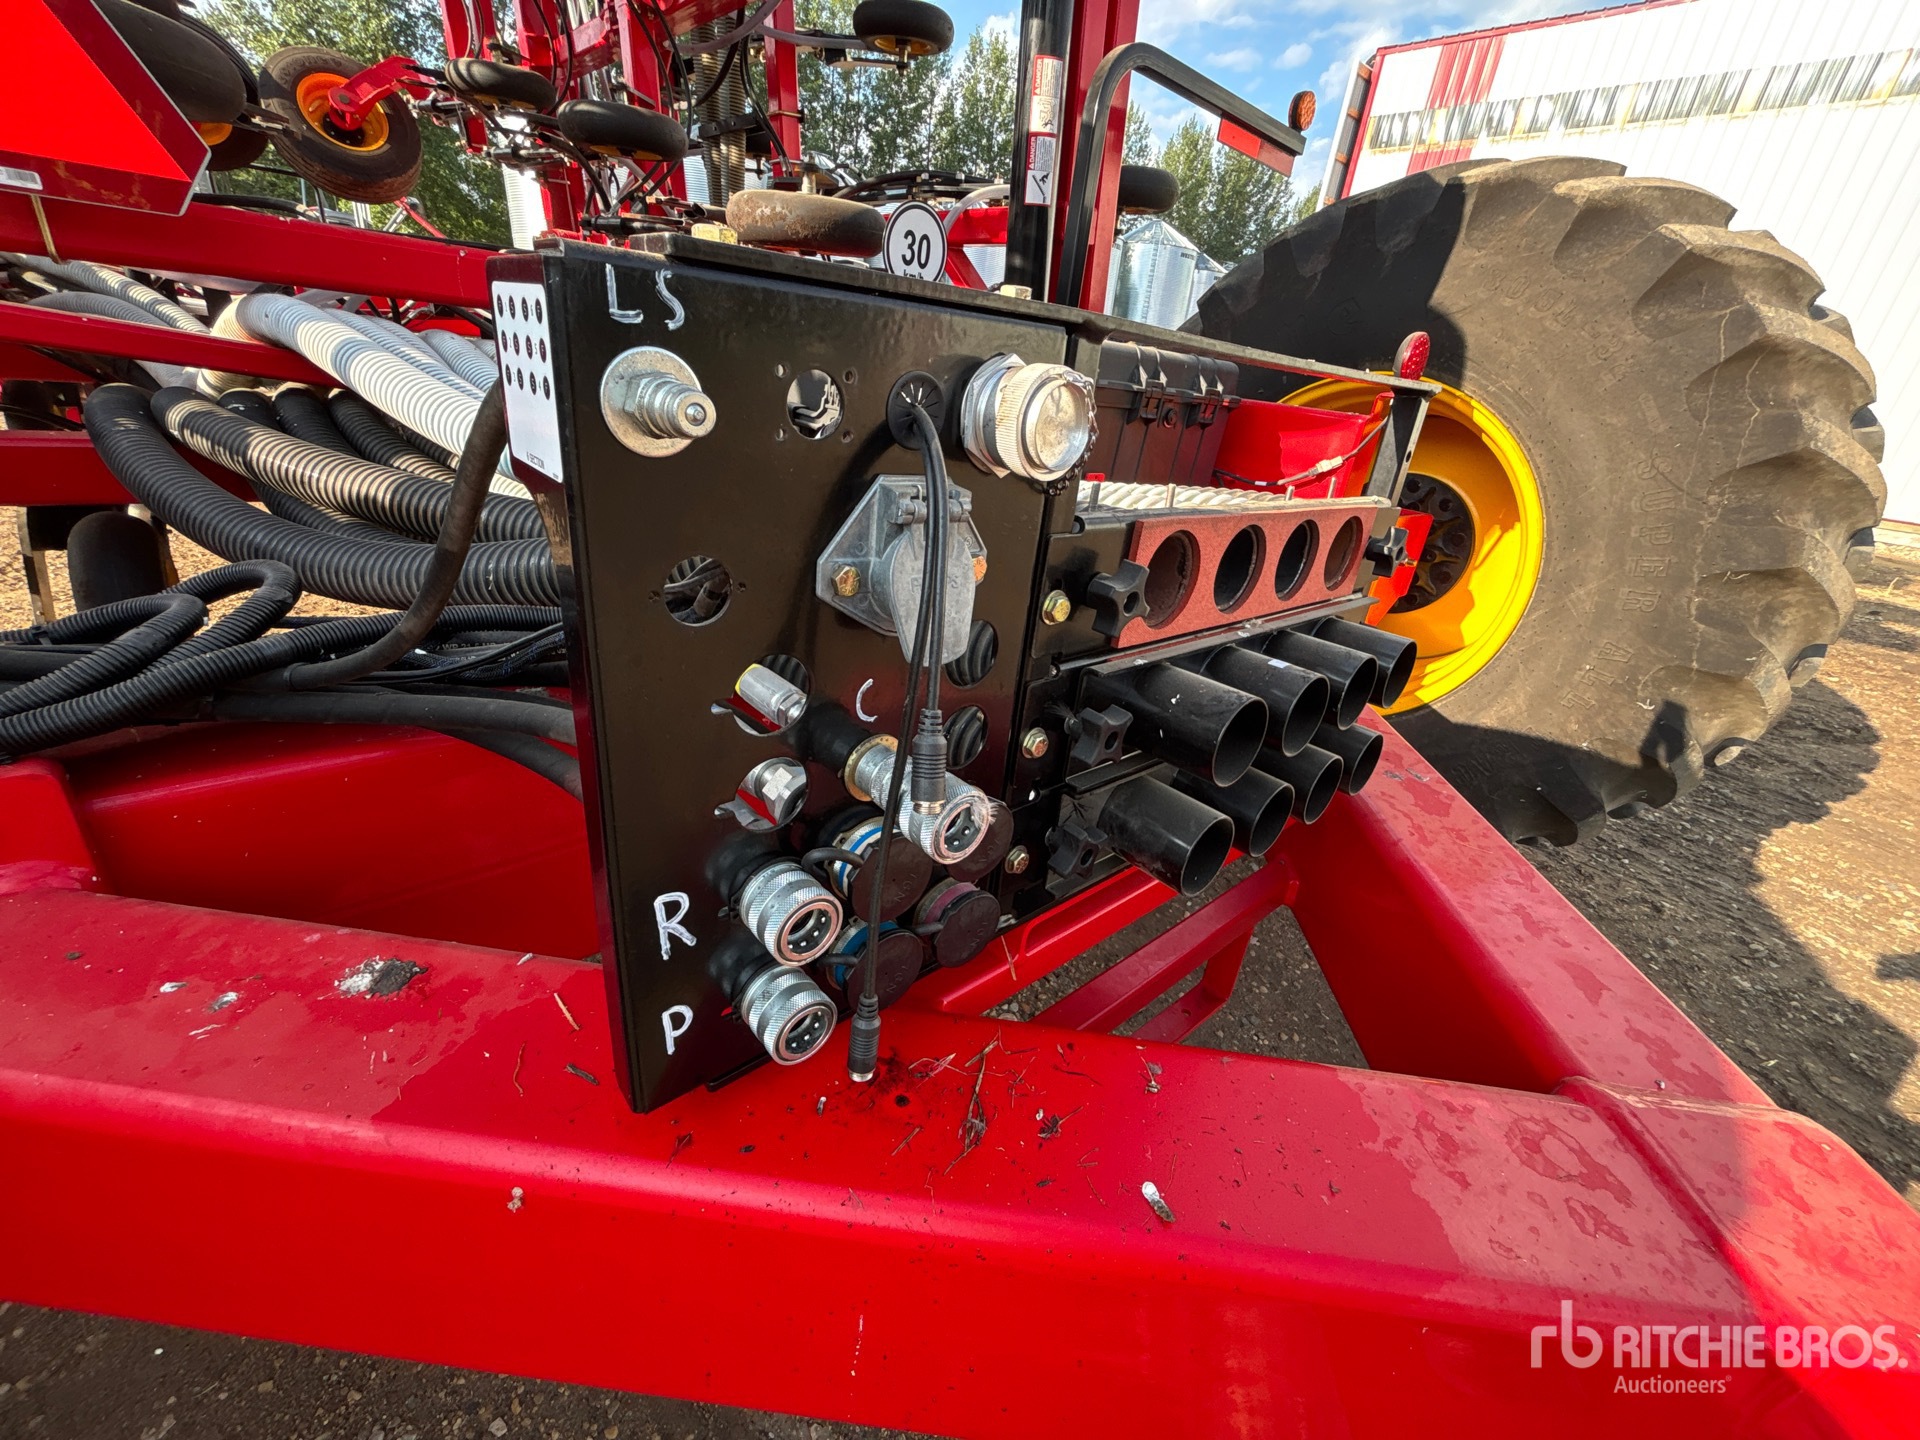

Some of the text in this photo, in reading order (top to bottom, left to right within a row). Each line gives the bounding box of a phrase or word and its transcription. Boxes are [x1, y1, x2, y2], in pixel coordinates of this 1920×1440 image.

[901, 229, 931, 270] 30
[530, 453, 545, 470] SECTION
[1559, 454, 1678, 711] SUPER ALL
[855, 677, 879, 723] C
[653, 891, 698, 960] R
[660, 1004, 694, 1056] P
